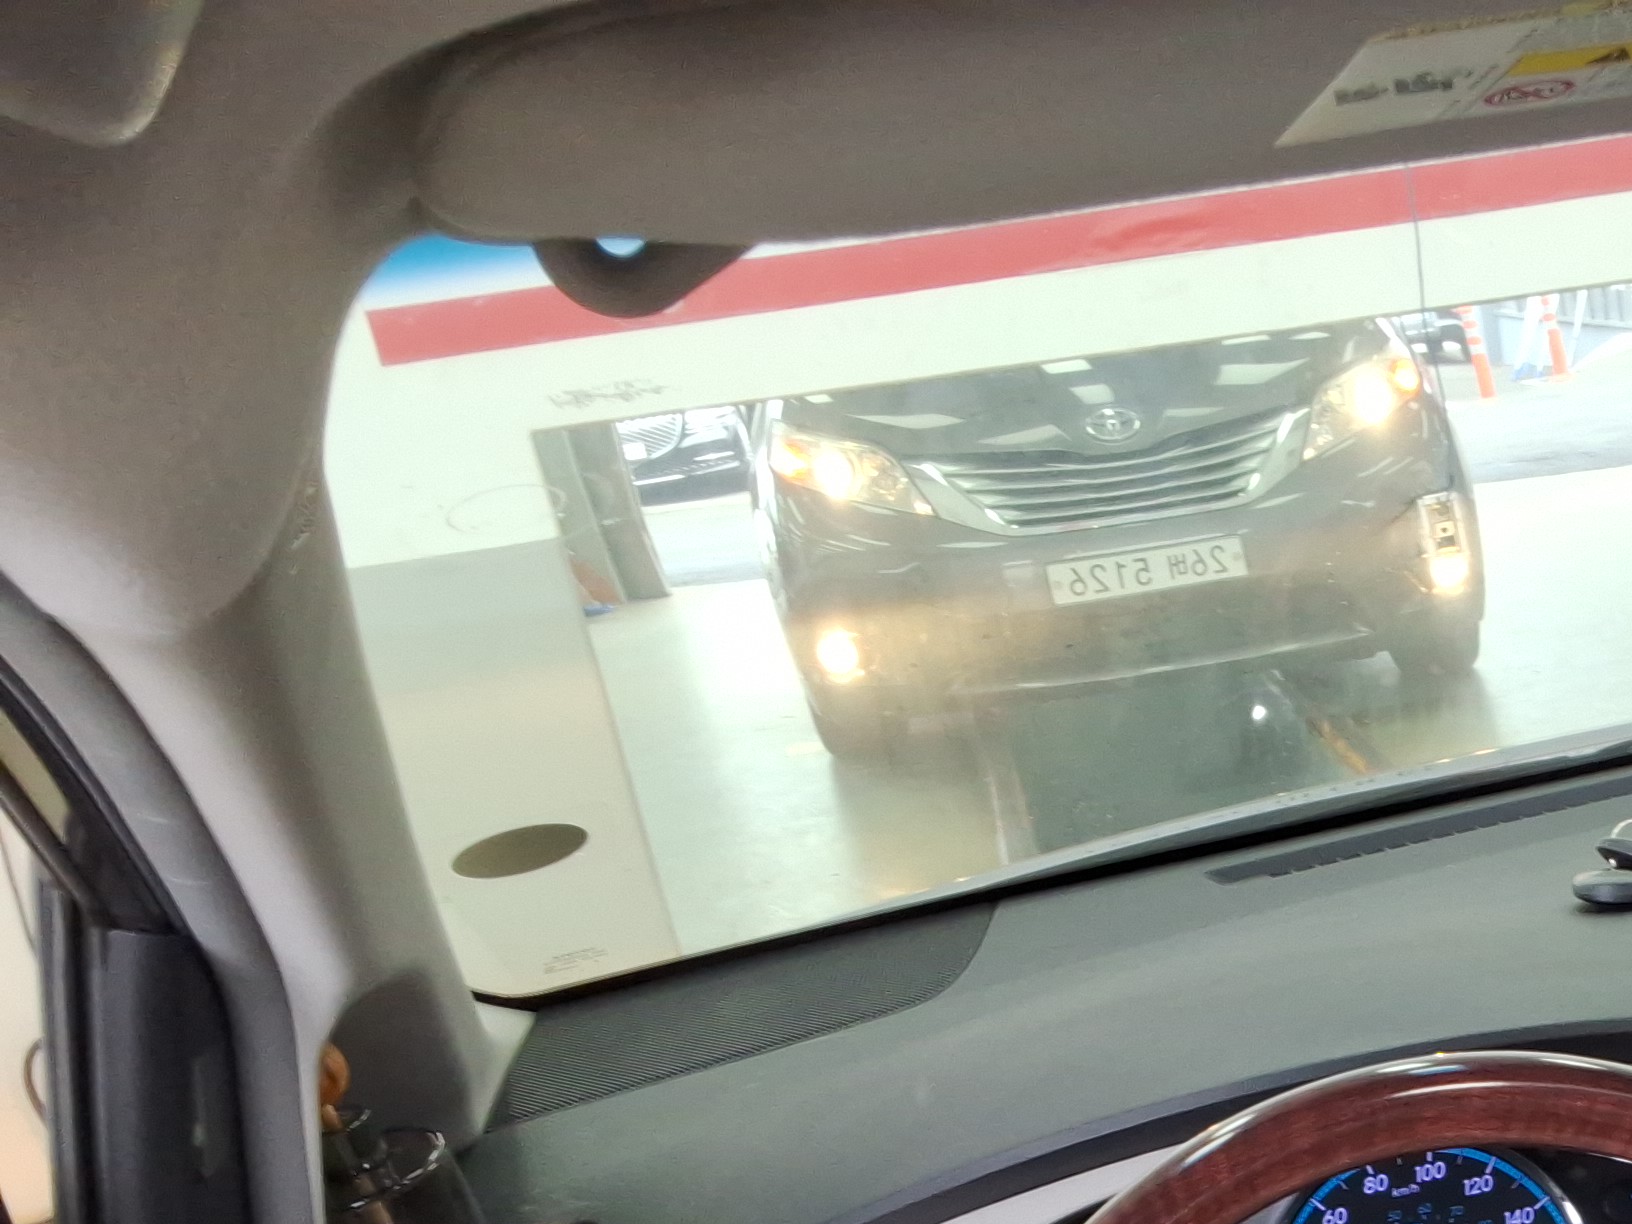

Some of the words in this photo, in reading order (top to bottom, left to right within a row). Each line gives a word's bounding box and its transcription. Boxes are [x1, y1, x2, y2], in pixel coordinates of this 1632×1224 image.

[1414, 1161, 1447, 1183] 100
[1363, 1174, 1389, 1195] 80
[1391, 1183, 1420, 1198] km/h
[1463, 1175, 1494, 1196] 120
